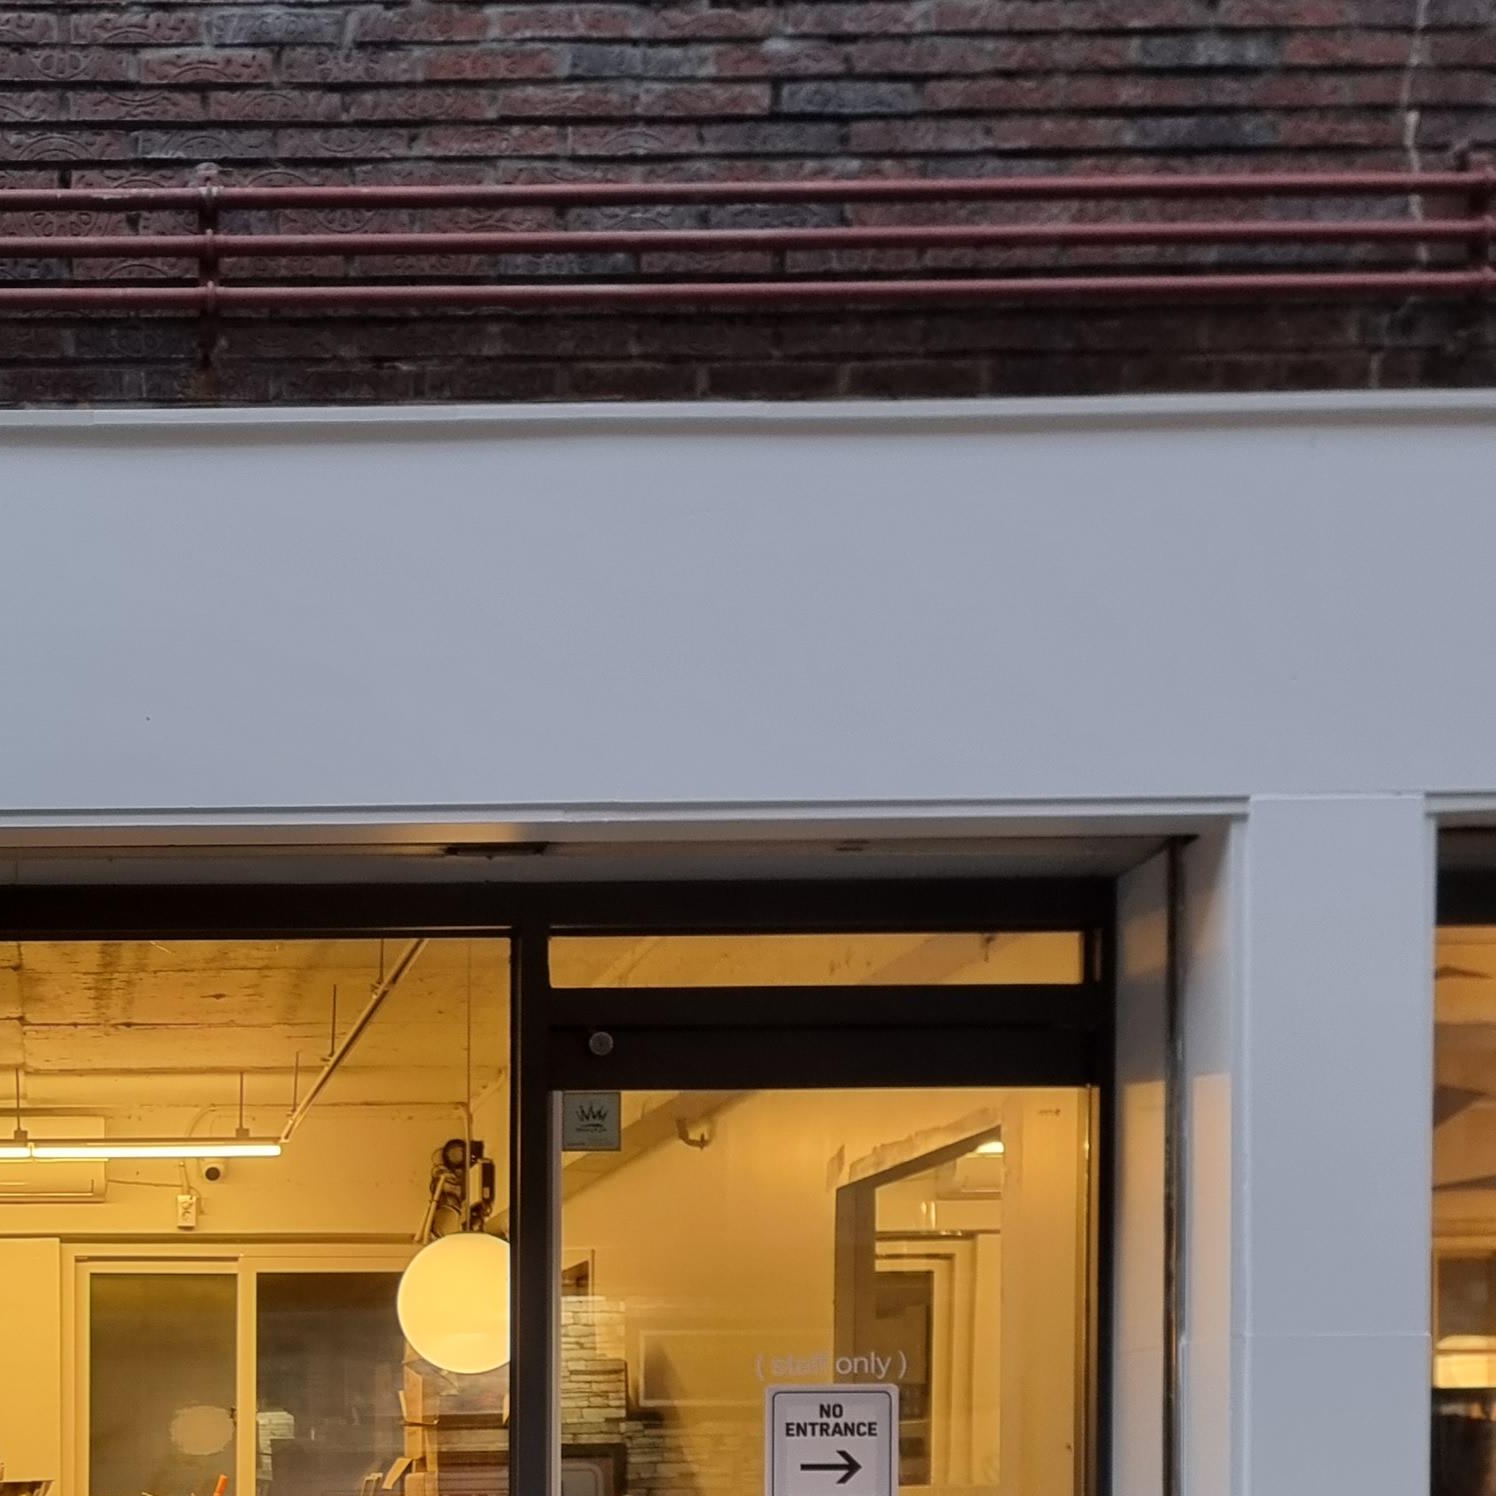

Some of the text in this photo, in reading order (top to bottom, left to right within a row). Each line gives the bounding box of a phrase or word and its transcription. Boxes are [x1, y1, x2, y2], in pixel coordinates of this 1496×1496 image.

[771, 1350, 830, 1377] staff
[835, 1352, 891, 1379] only
[819, 1403, 844, 1419] NO
[784, 1421, 878, 1437] ENTRANCE
